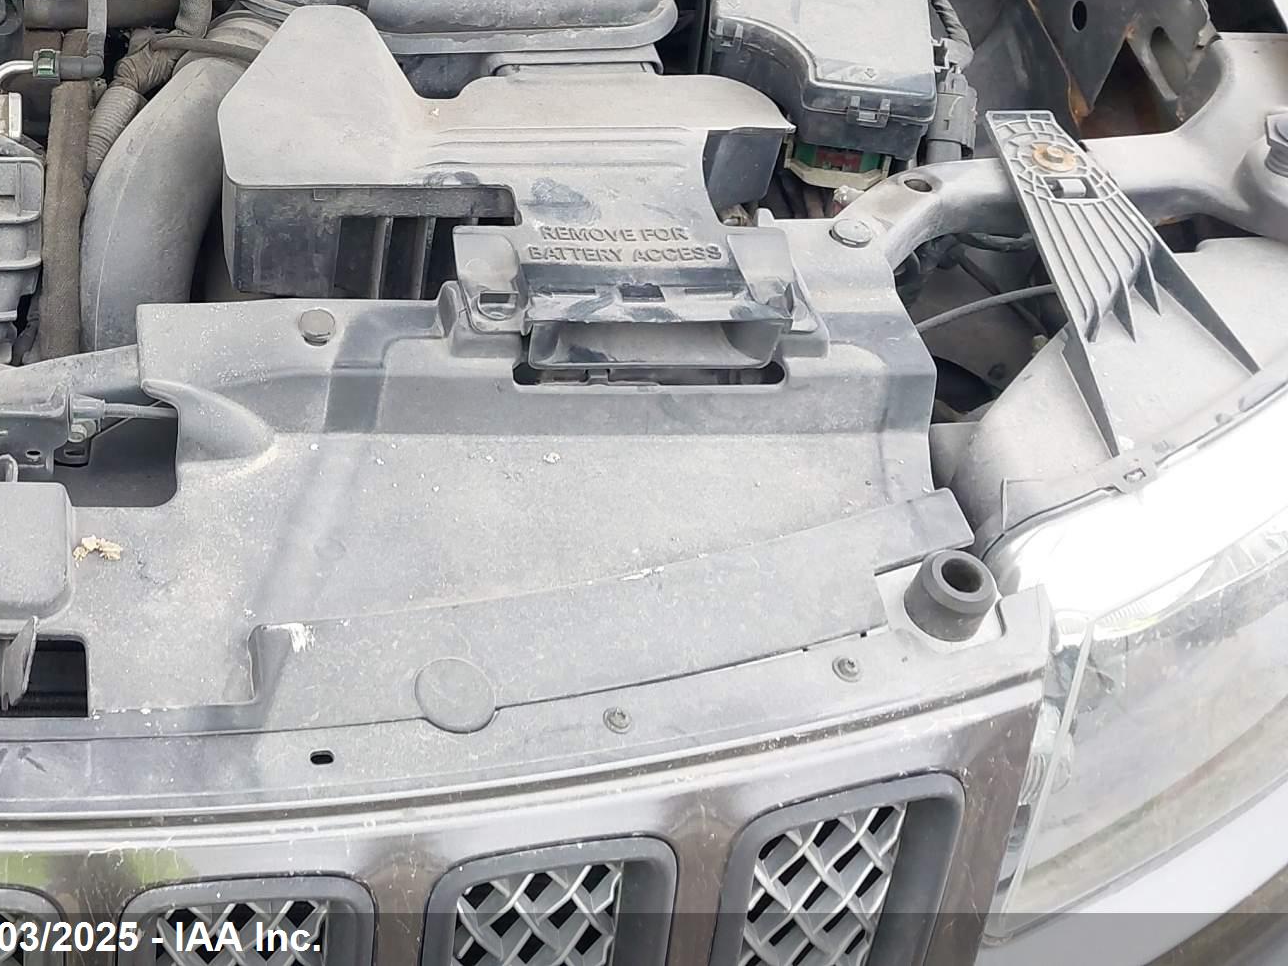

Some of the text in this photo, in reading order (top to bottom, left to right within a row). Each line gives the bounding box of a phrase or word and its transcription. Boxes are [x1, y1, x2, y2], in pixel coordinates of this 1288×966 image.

[540, 225, 689, 242] REMOVE FOR
[527, 243, 722, 263] BATTERY ACCESS
